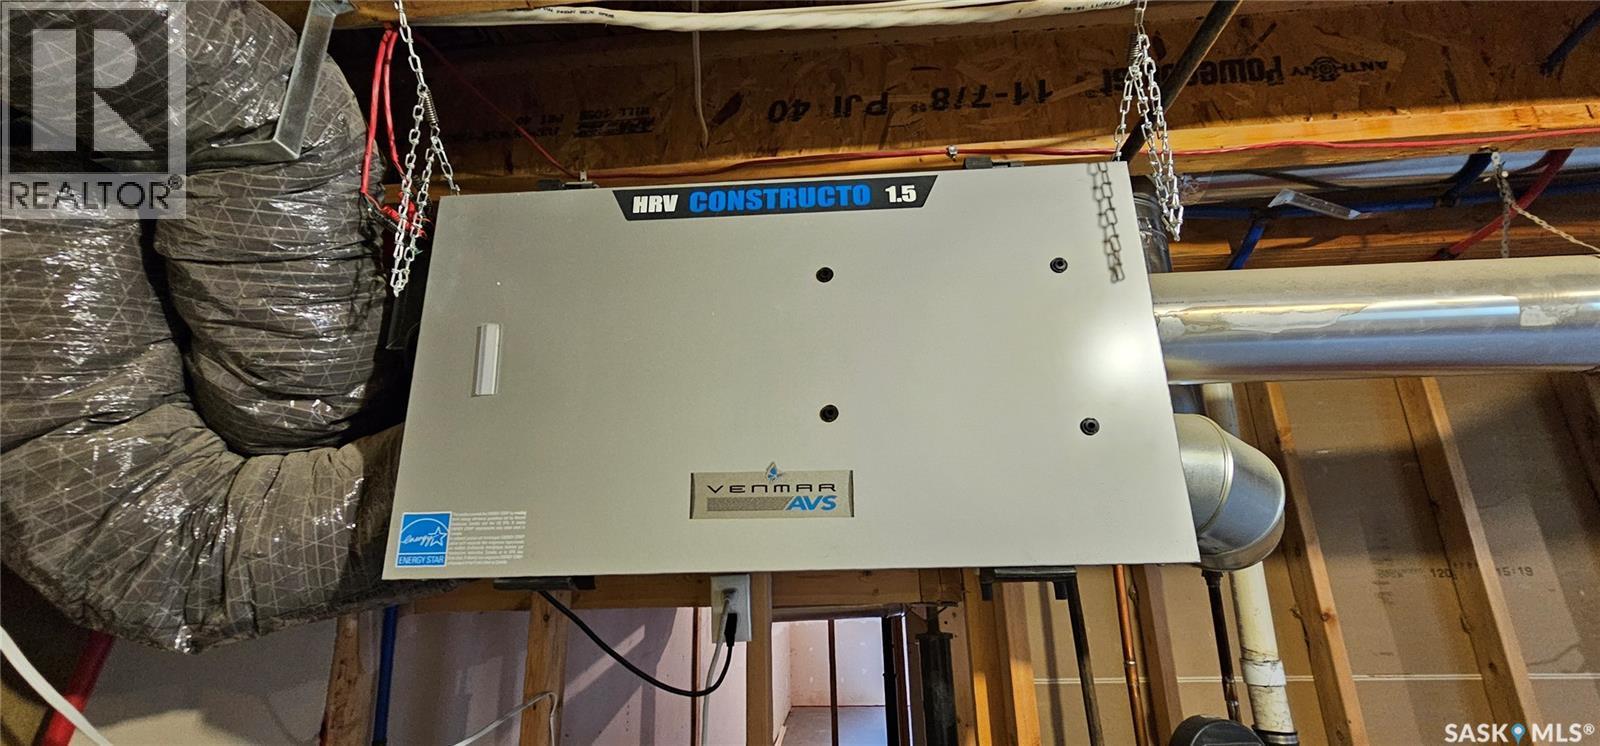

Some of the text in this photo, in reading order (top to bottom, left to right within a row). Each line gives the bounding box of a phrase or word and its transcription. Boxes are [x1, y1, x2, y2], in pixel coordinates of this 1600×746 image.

[767, 98, 811, 124] 40
[632, 184, 917, 213] HRV CONSTRUCTO 1.5
[707, 484, 837, 494] VENMAR
[785, 495, 838, 511] AVS
[398, 555, 445, 565] ENERGY STAR
